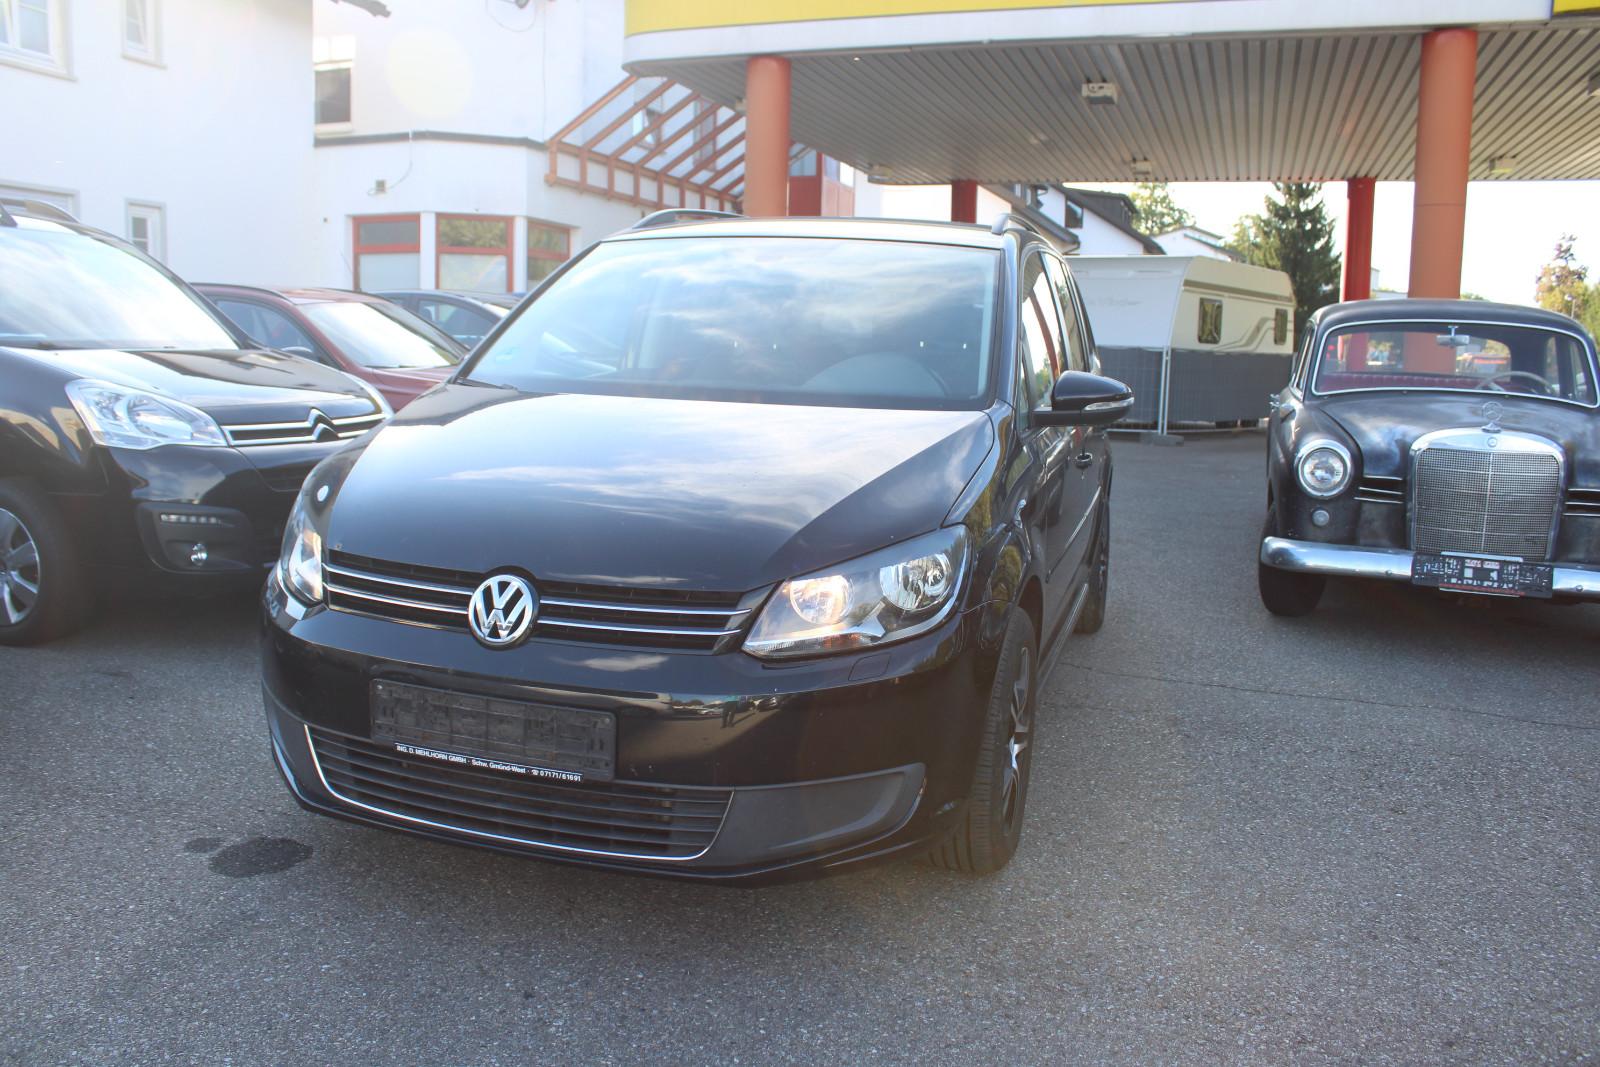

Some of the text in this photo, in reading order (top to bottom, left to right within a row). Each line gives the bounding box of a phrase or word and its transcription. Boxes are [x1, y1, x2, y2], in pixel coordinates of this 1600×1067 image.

[415, 748, 448, 761] MEHLHORN
[471, 759, 489, 768] Schw.
[489, 763, 526, 774] Gmünd-West
